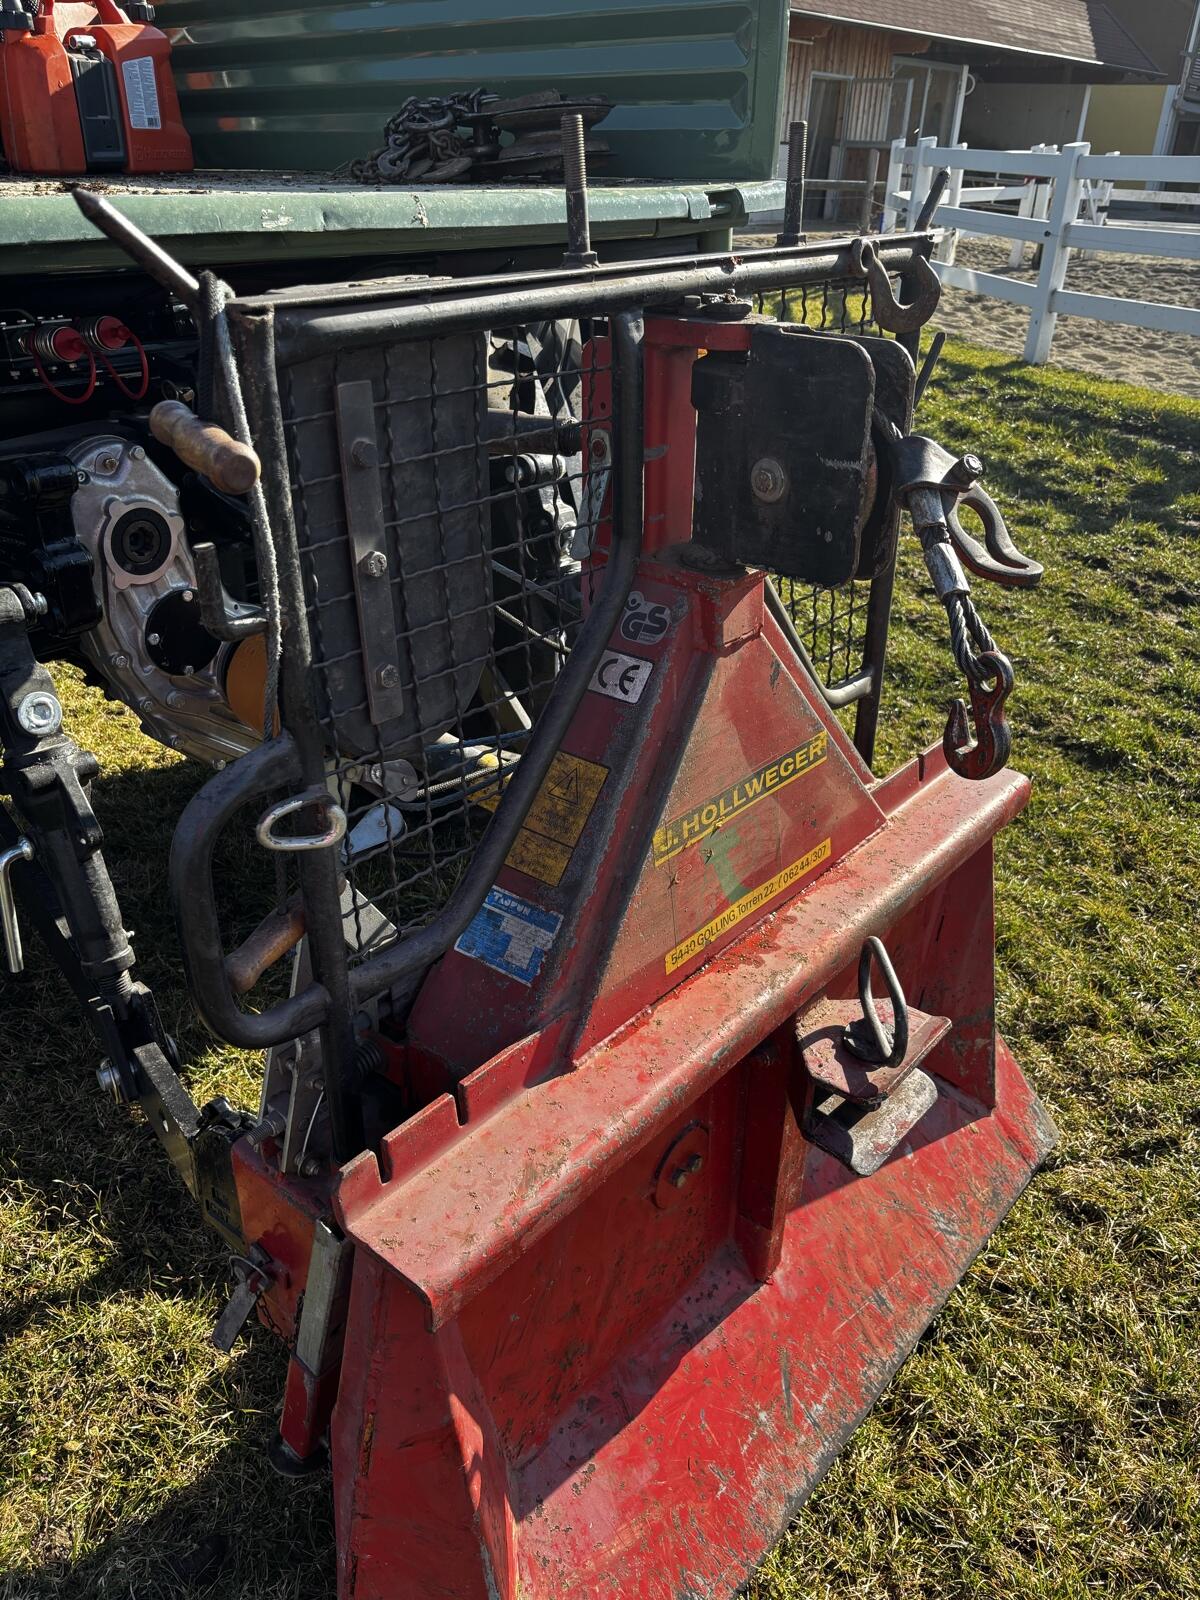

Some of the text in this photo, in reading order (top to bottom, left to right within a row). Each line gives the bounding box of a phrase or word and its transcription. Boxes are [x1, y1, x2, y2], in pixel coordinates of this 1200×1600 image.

[621, 605, 669, 640] GS
[598, 658, 641, 696] CE
[683, 740, 826, 839] HOLLWEGER
[738, 893, 763, 915] Torren
